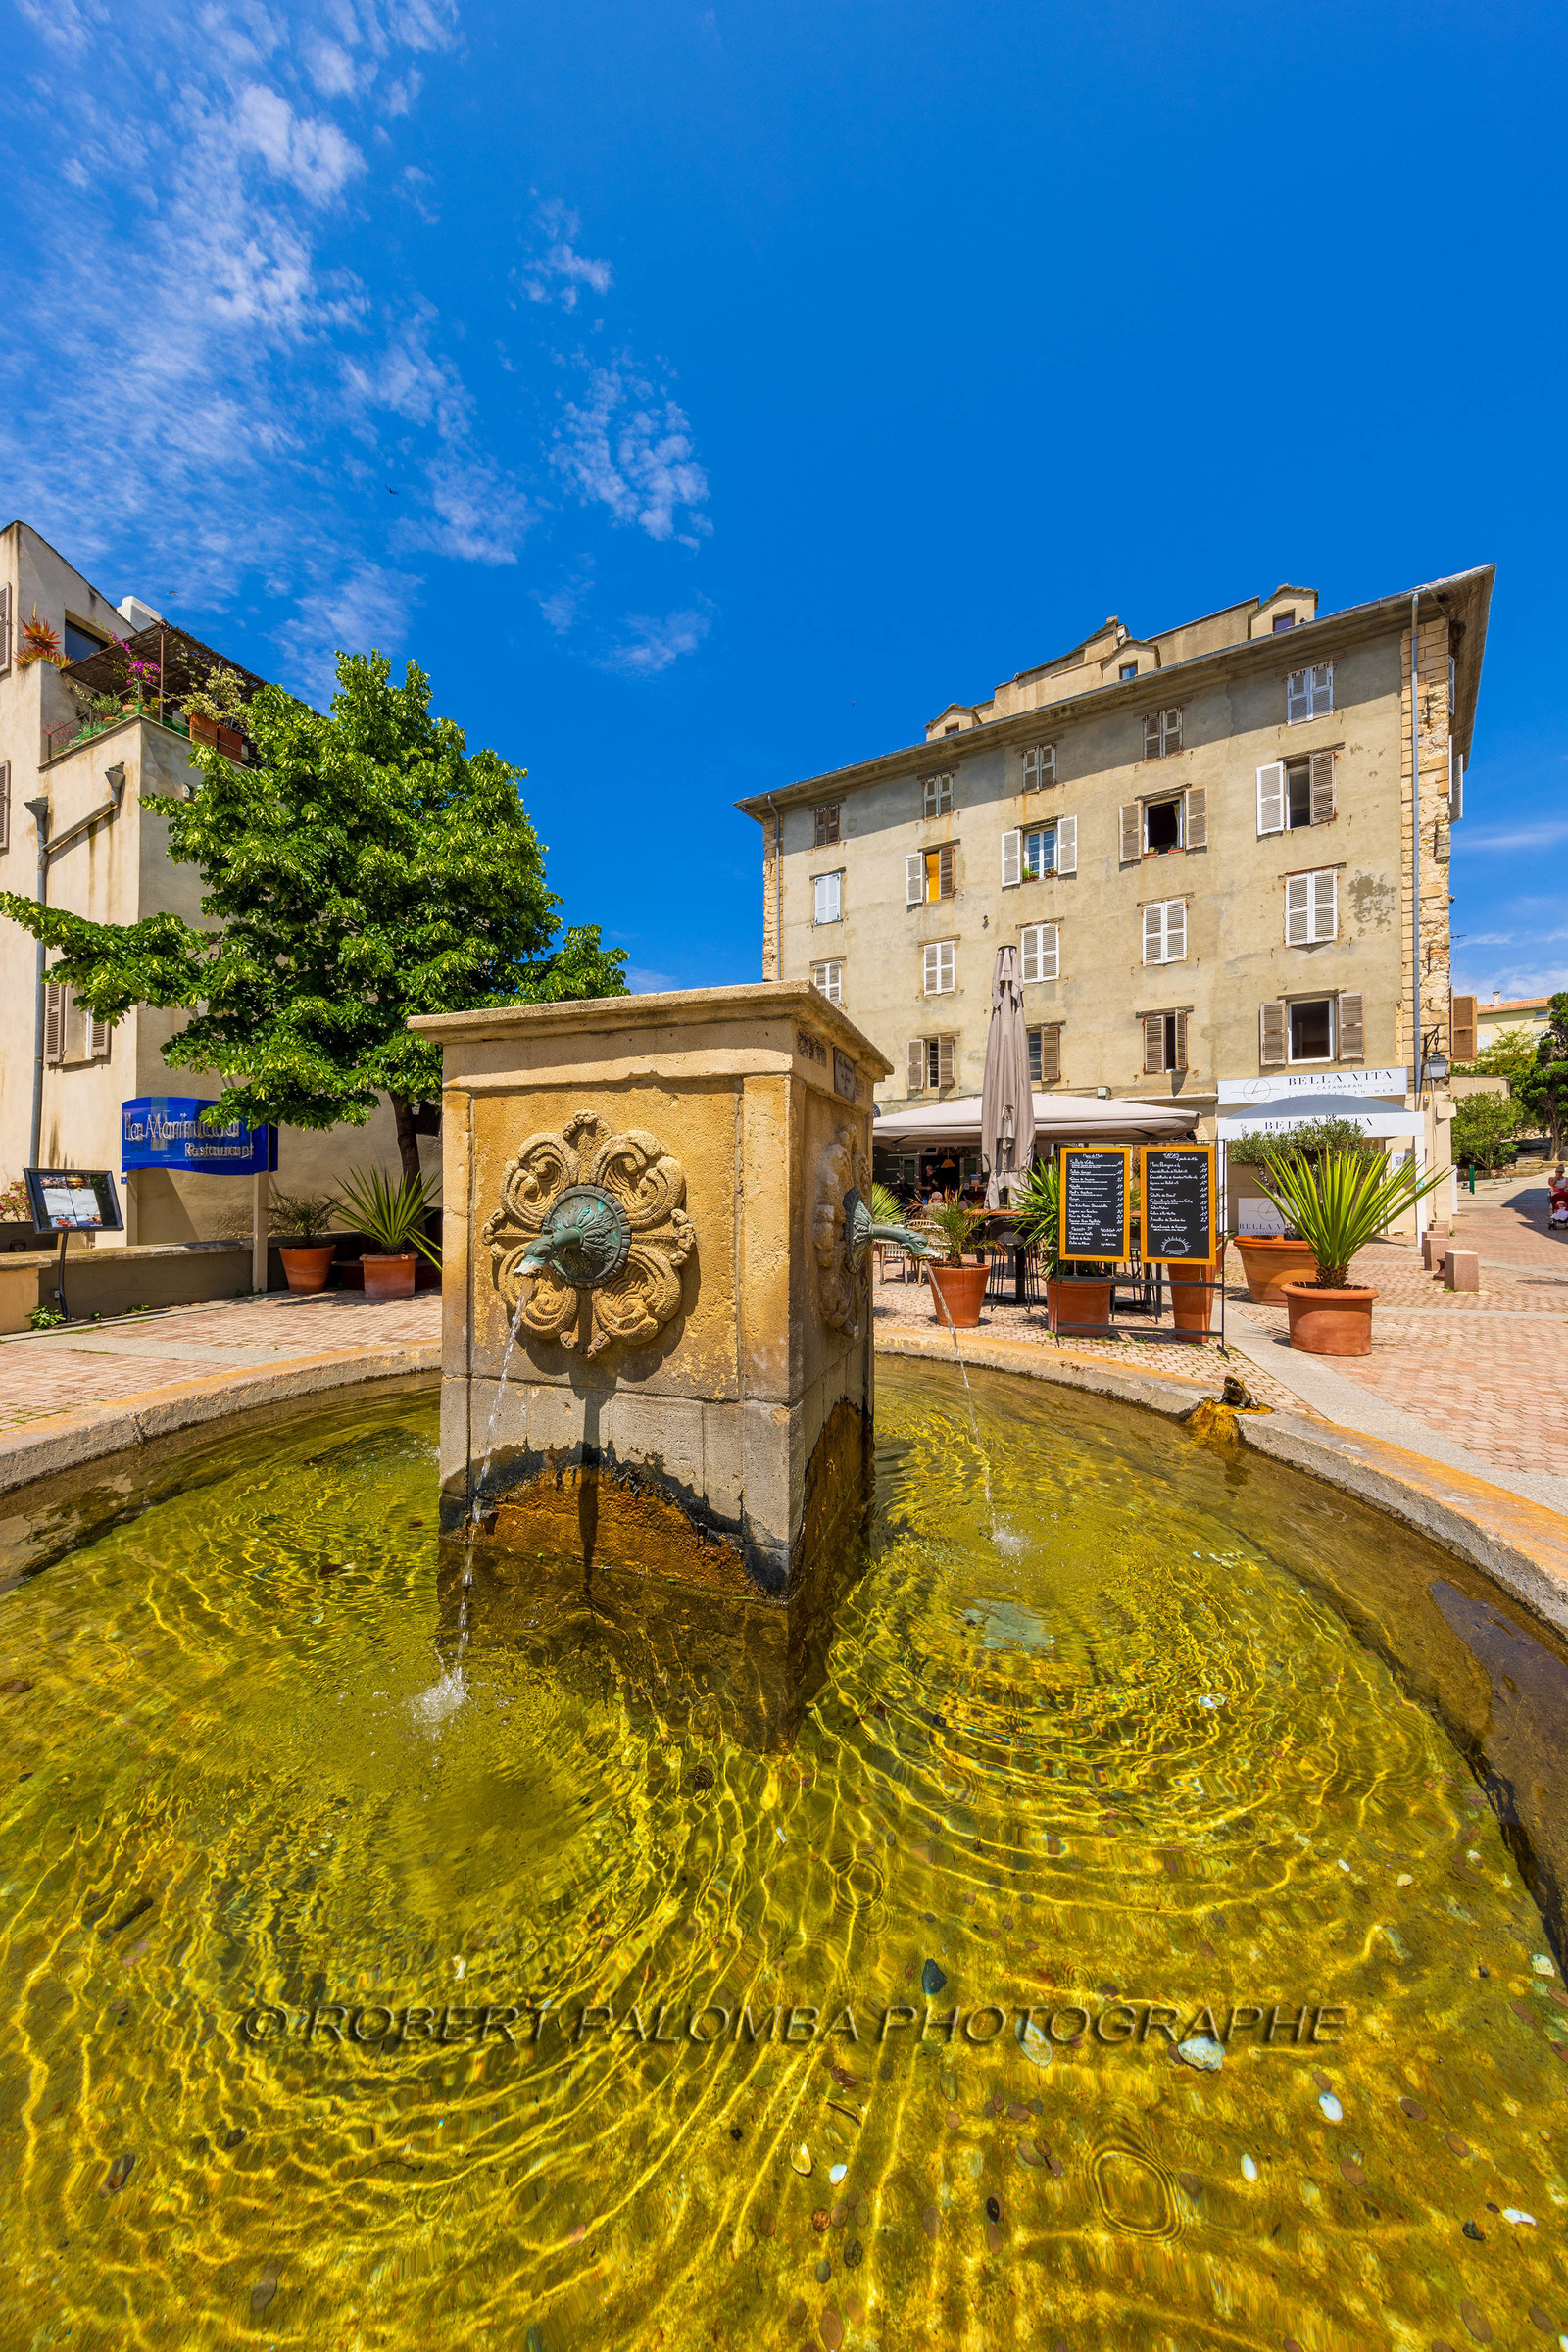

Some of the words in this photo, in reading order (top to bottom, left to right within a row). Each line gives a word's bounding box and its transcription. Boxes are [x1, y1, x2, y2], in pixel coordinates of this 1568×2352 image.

[1289, 1074, 1342, 1086] BELLA
[1352, 1071, 1392, 1081] VITA
[184, 1142, 254, 1158] Restaurant
